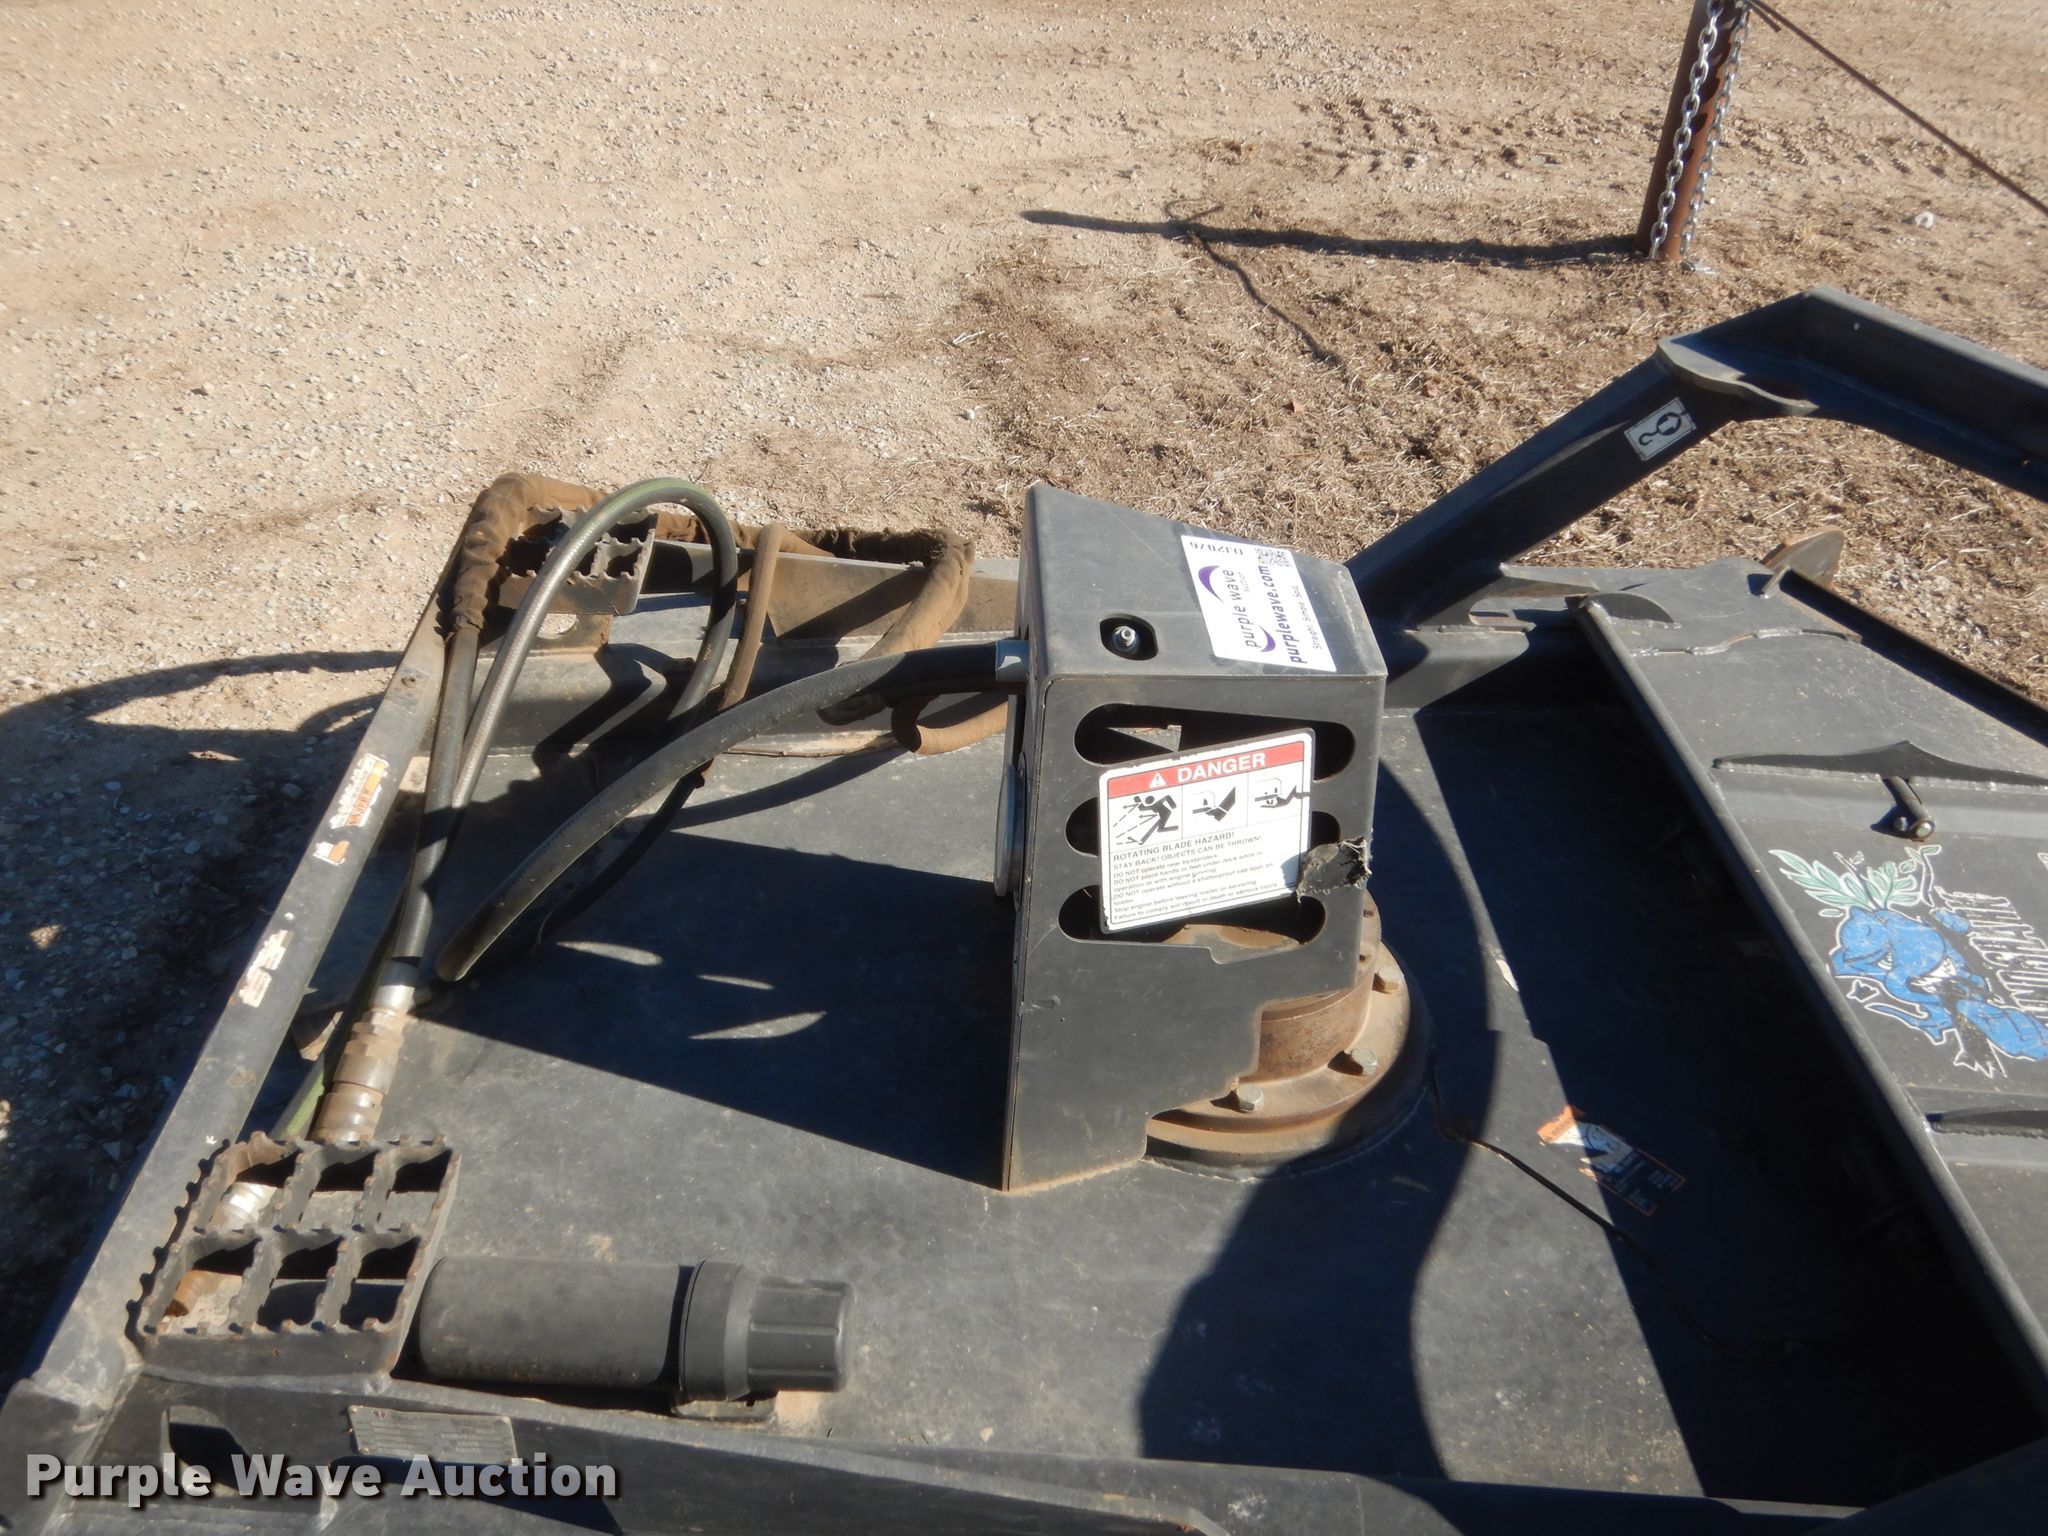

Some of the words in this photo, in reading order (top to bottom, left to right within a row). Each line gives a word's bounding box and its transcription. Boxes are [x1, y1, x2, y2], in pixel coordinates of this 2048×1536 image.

[1222, 569, 1242, 601] wave
[1232, 605, 1262, 648] purple
[1258, 565, 1308, 664] purplewave.com
[1177, 751, 1267, 783] DANGER
[1113, 847, 1160, 862] ROTATING
[1162, 840, 1193, 852] BLADE
[1194, 831, 1235, 845] HAZARD!
[1113, 862, 1133, 870] STAY
[1135, 856, 1160, 866] BACK!
[1161, 849, 1196, 861] OBJECTS
[1197, 845, 1213, 854] CAN
[1227, 835, 1262, 847] THROWN!
[1125, 868, 1140, 876] NOT
[1141, 864, 1166, 874] operate
[1125, 875, 1140, 884] NOT
[1125, 889, 1140, 897] NOT
